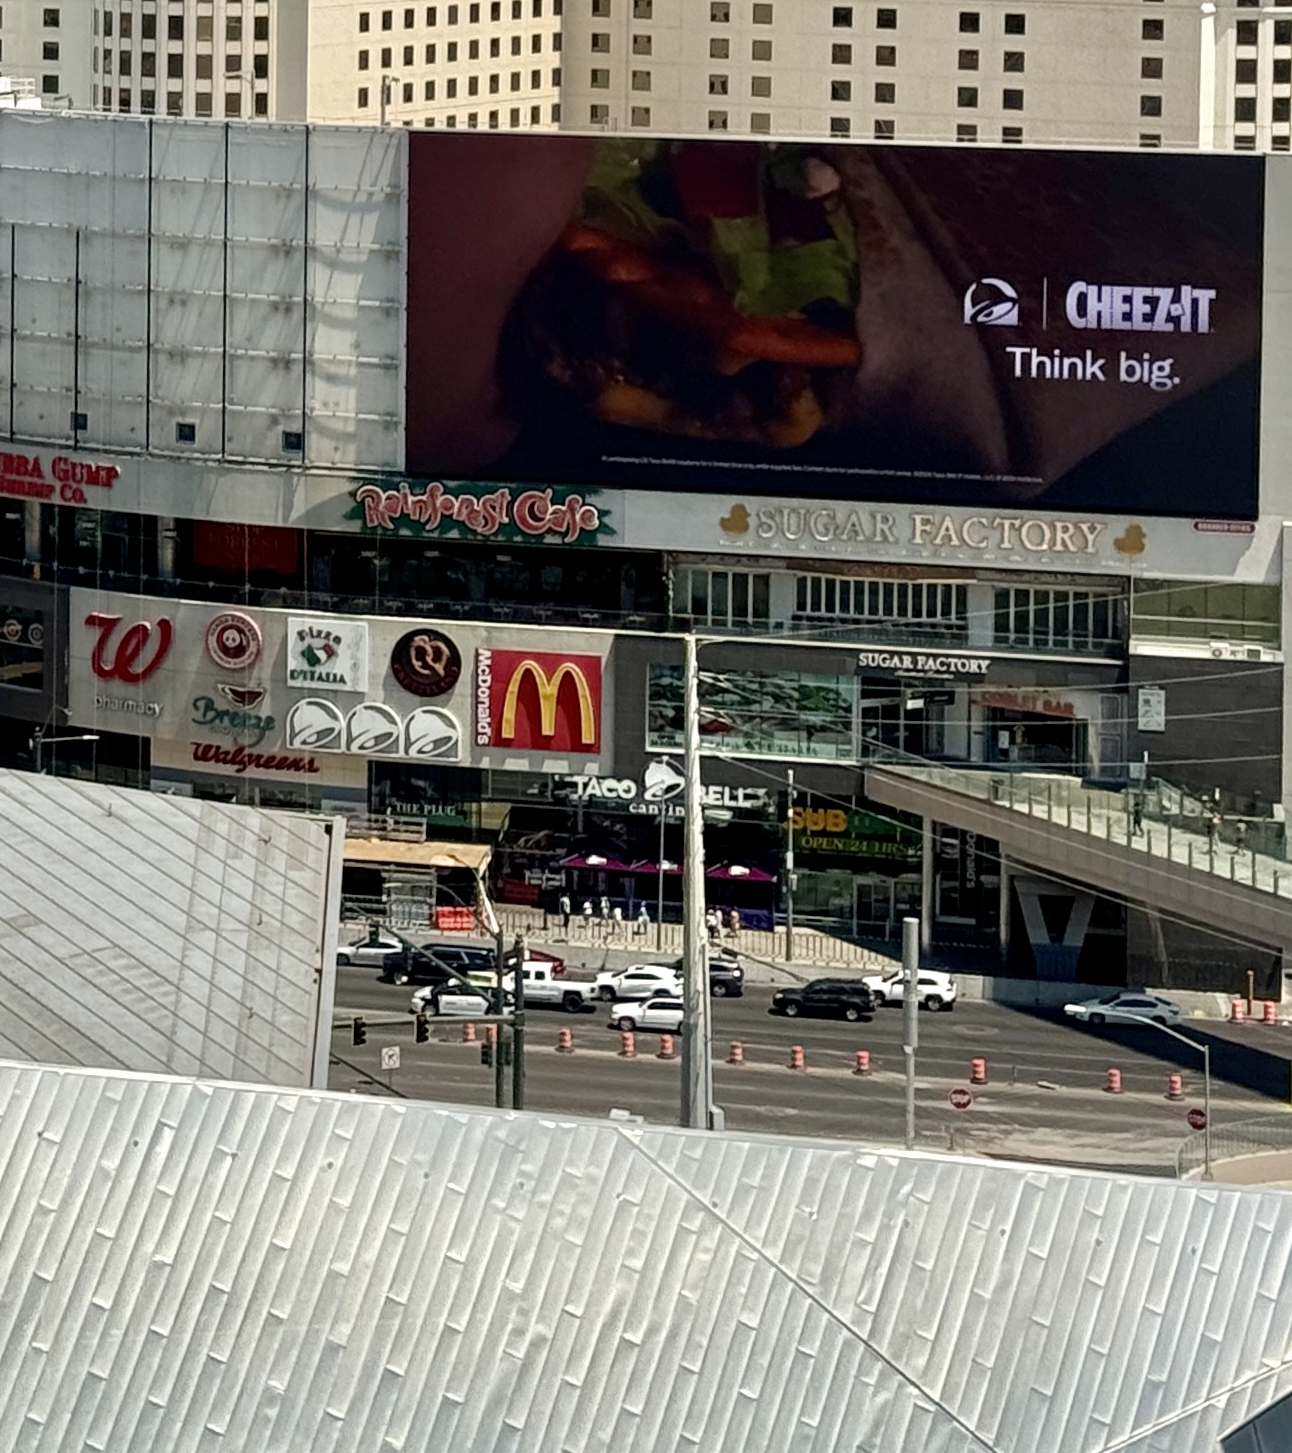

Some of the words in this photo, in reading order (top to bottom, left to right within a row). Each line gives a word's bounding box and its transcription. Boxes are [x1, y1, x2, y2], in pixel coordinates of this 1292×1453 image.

[1006, 347, 1107, 382] Think
[1120, 351, 1181, 392] big.
[357, 481, 511, 536] Rainforest
[756, 504, 898, 544] SUGAR
[911, 513, 1108, 554] FACTORY
[858, 653, 915, 669] SUGAR
[917, 656, 991, 675] FACTORY
[94, 696, 165, 719] pharmacy
[191, 742, 321, 774] Walgreens
[575, 776, 637, 800] TACO
[801, 836, 845, 850] OPEN
[848, 840, 868, 852] 24
